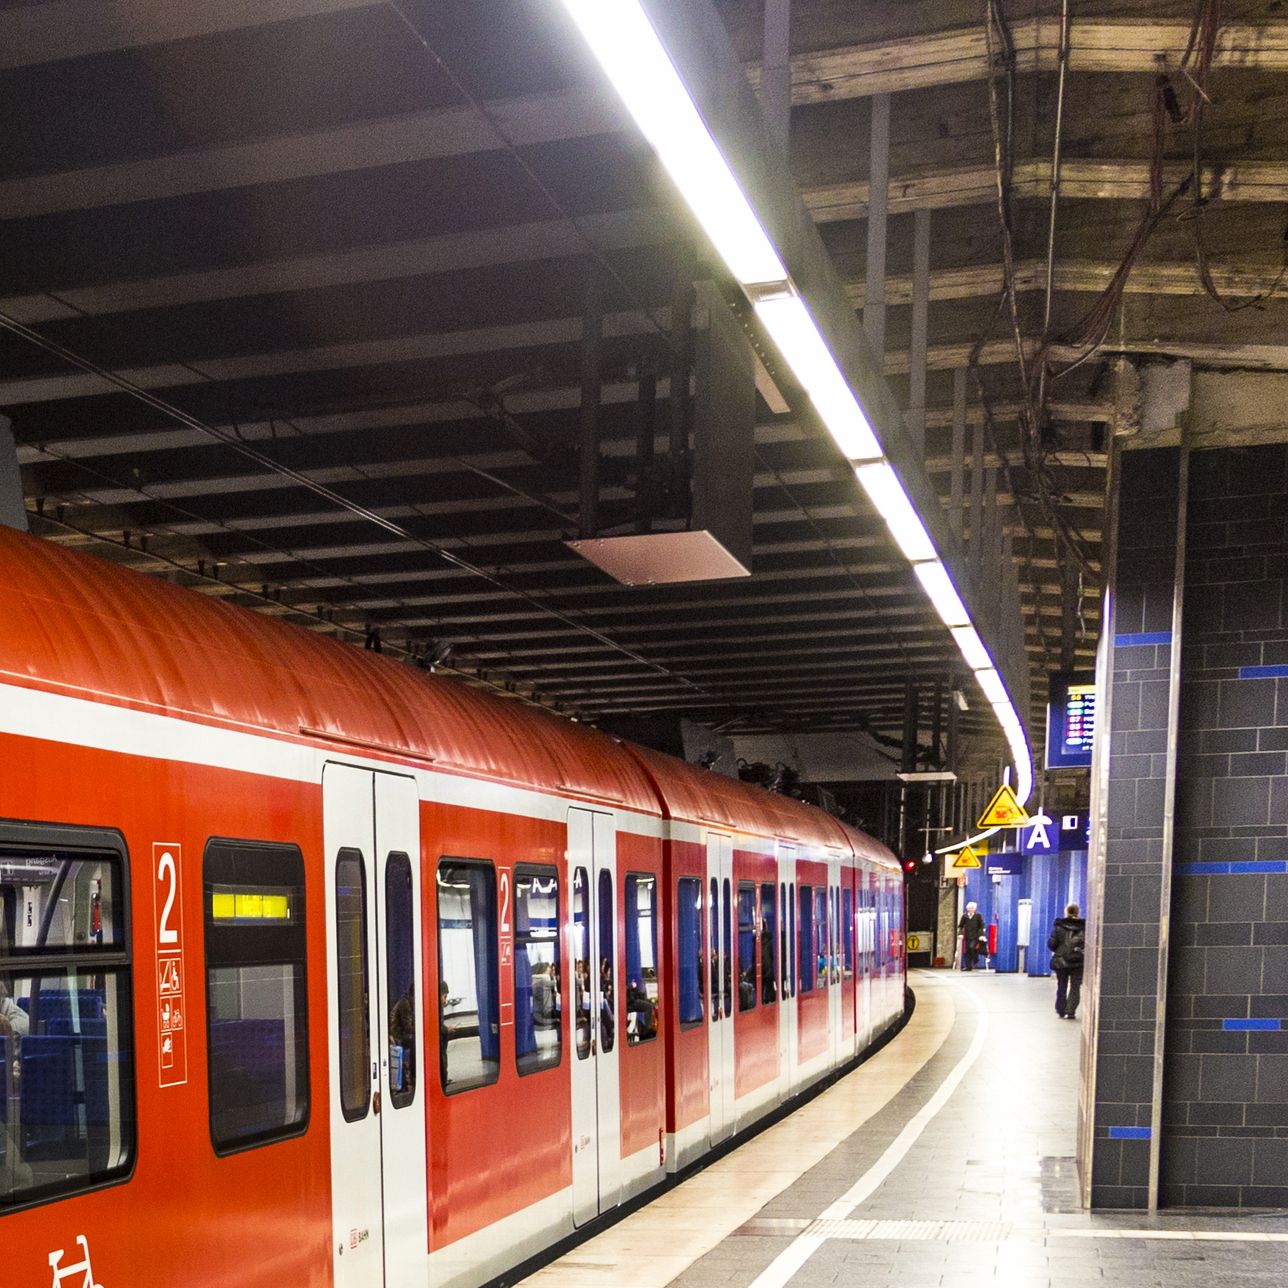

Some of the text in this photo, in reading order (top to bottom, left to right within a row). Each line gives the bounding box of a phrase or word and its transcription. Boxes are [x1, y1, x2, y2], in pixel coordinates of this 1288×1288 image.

[1026, 823, 1051, 849] A
[157, 851, 178, 944] 2
[500, 872, 510, 933] 2
